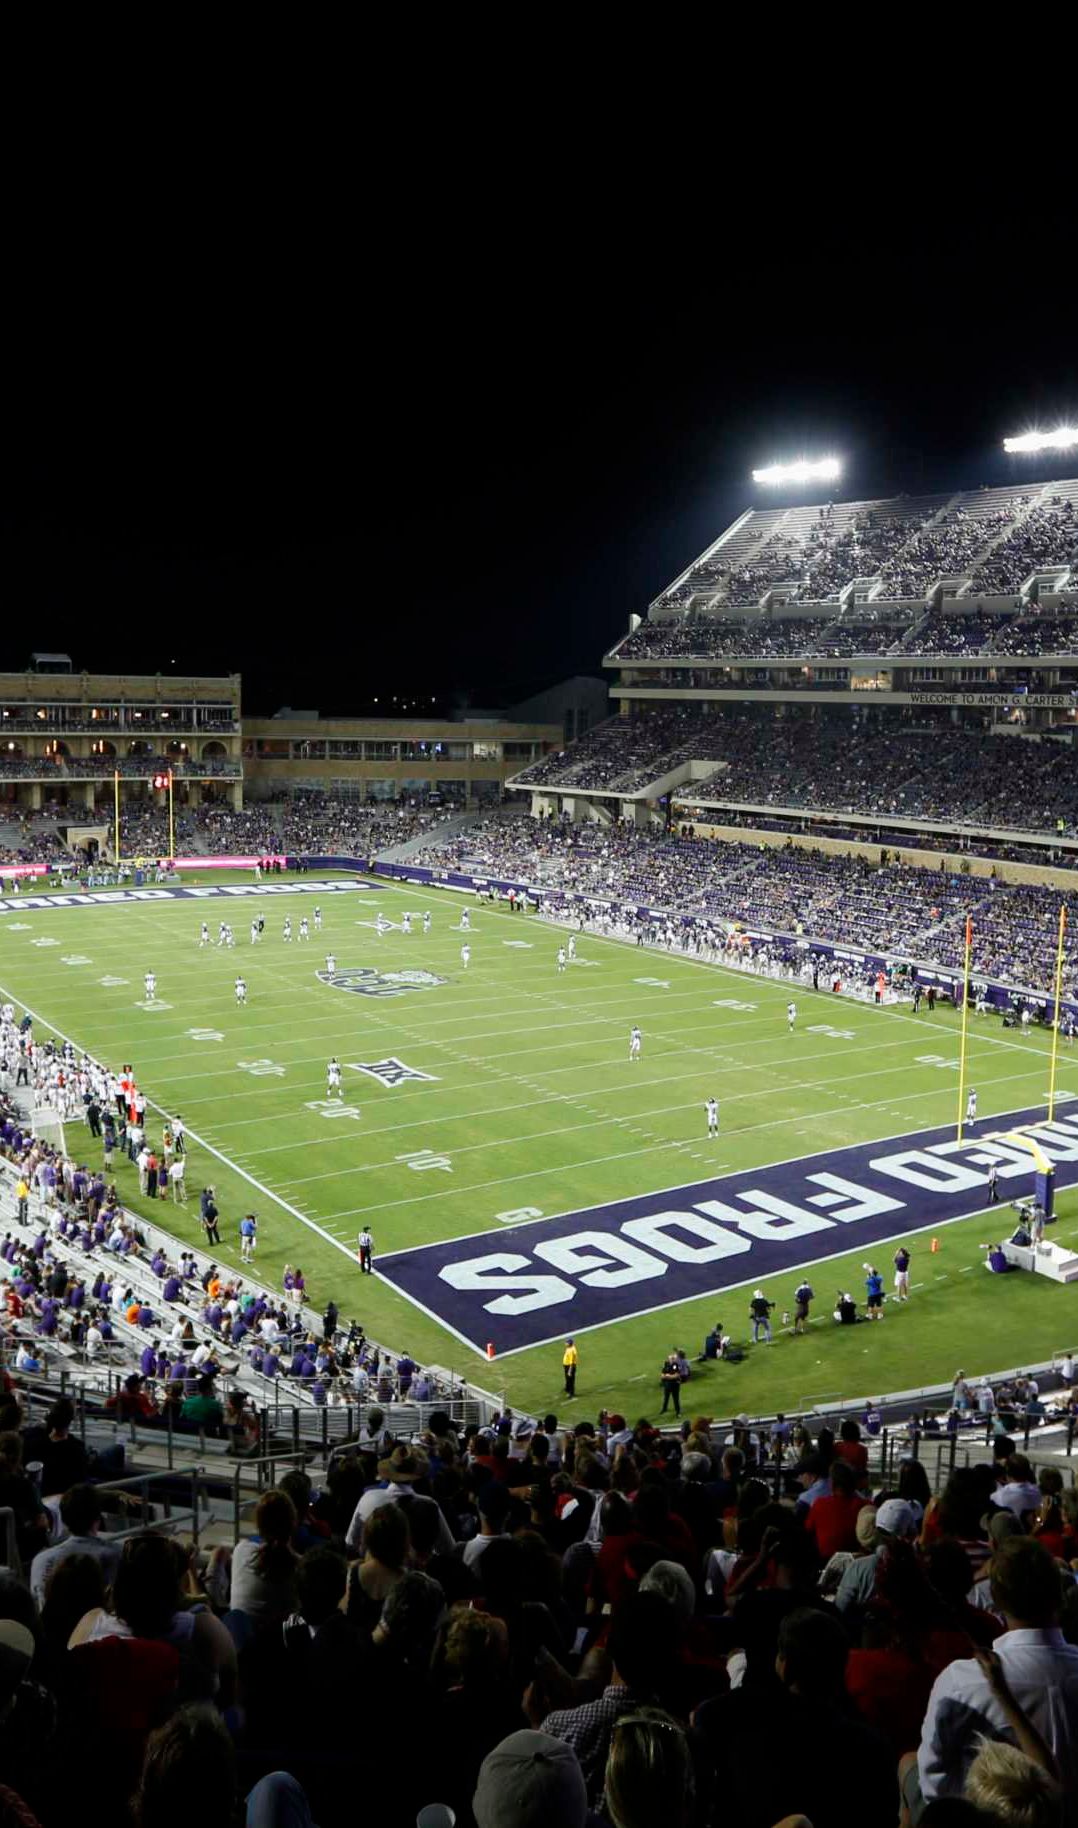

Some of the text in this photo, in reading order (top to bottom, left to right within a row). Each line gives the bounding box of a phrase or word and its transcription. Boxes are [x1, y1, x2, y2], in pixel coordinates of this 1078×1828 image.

[911, 694, 957, 704] WELCOME
[961, 695, 975, 704] TO
[978, 695, 1008, 705] AMON
[1025, 695, 1064, 705] CARTER
[237, 1058, 286, 1076] 30
[304, 1098, 361, 1119] 20
[394, 1149, 453, 1172] 10
[438, 1172, 907, 1315] FROGS
